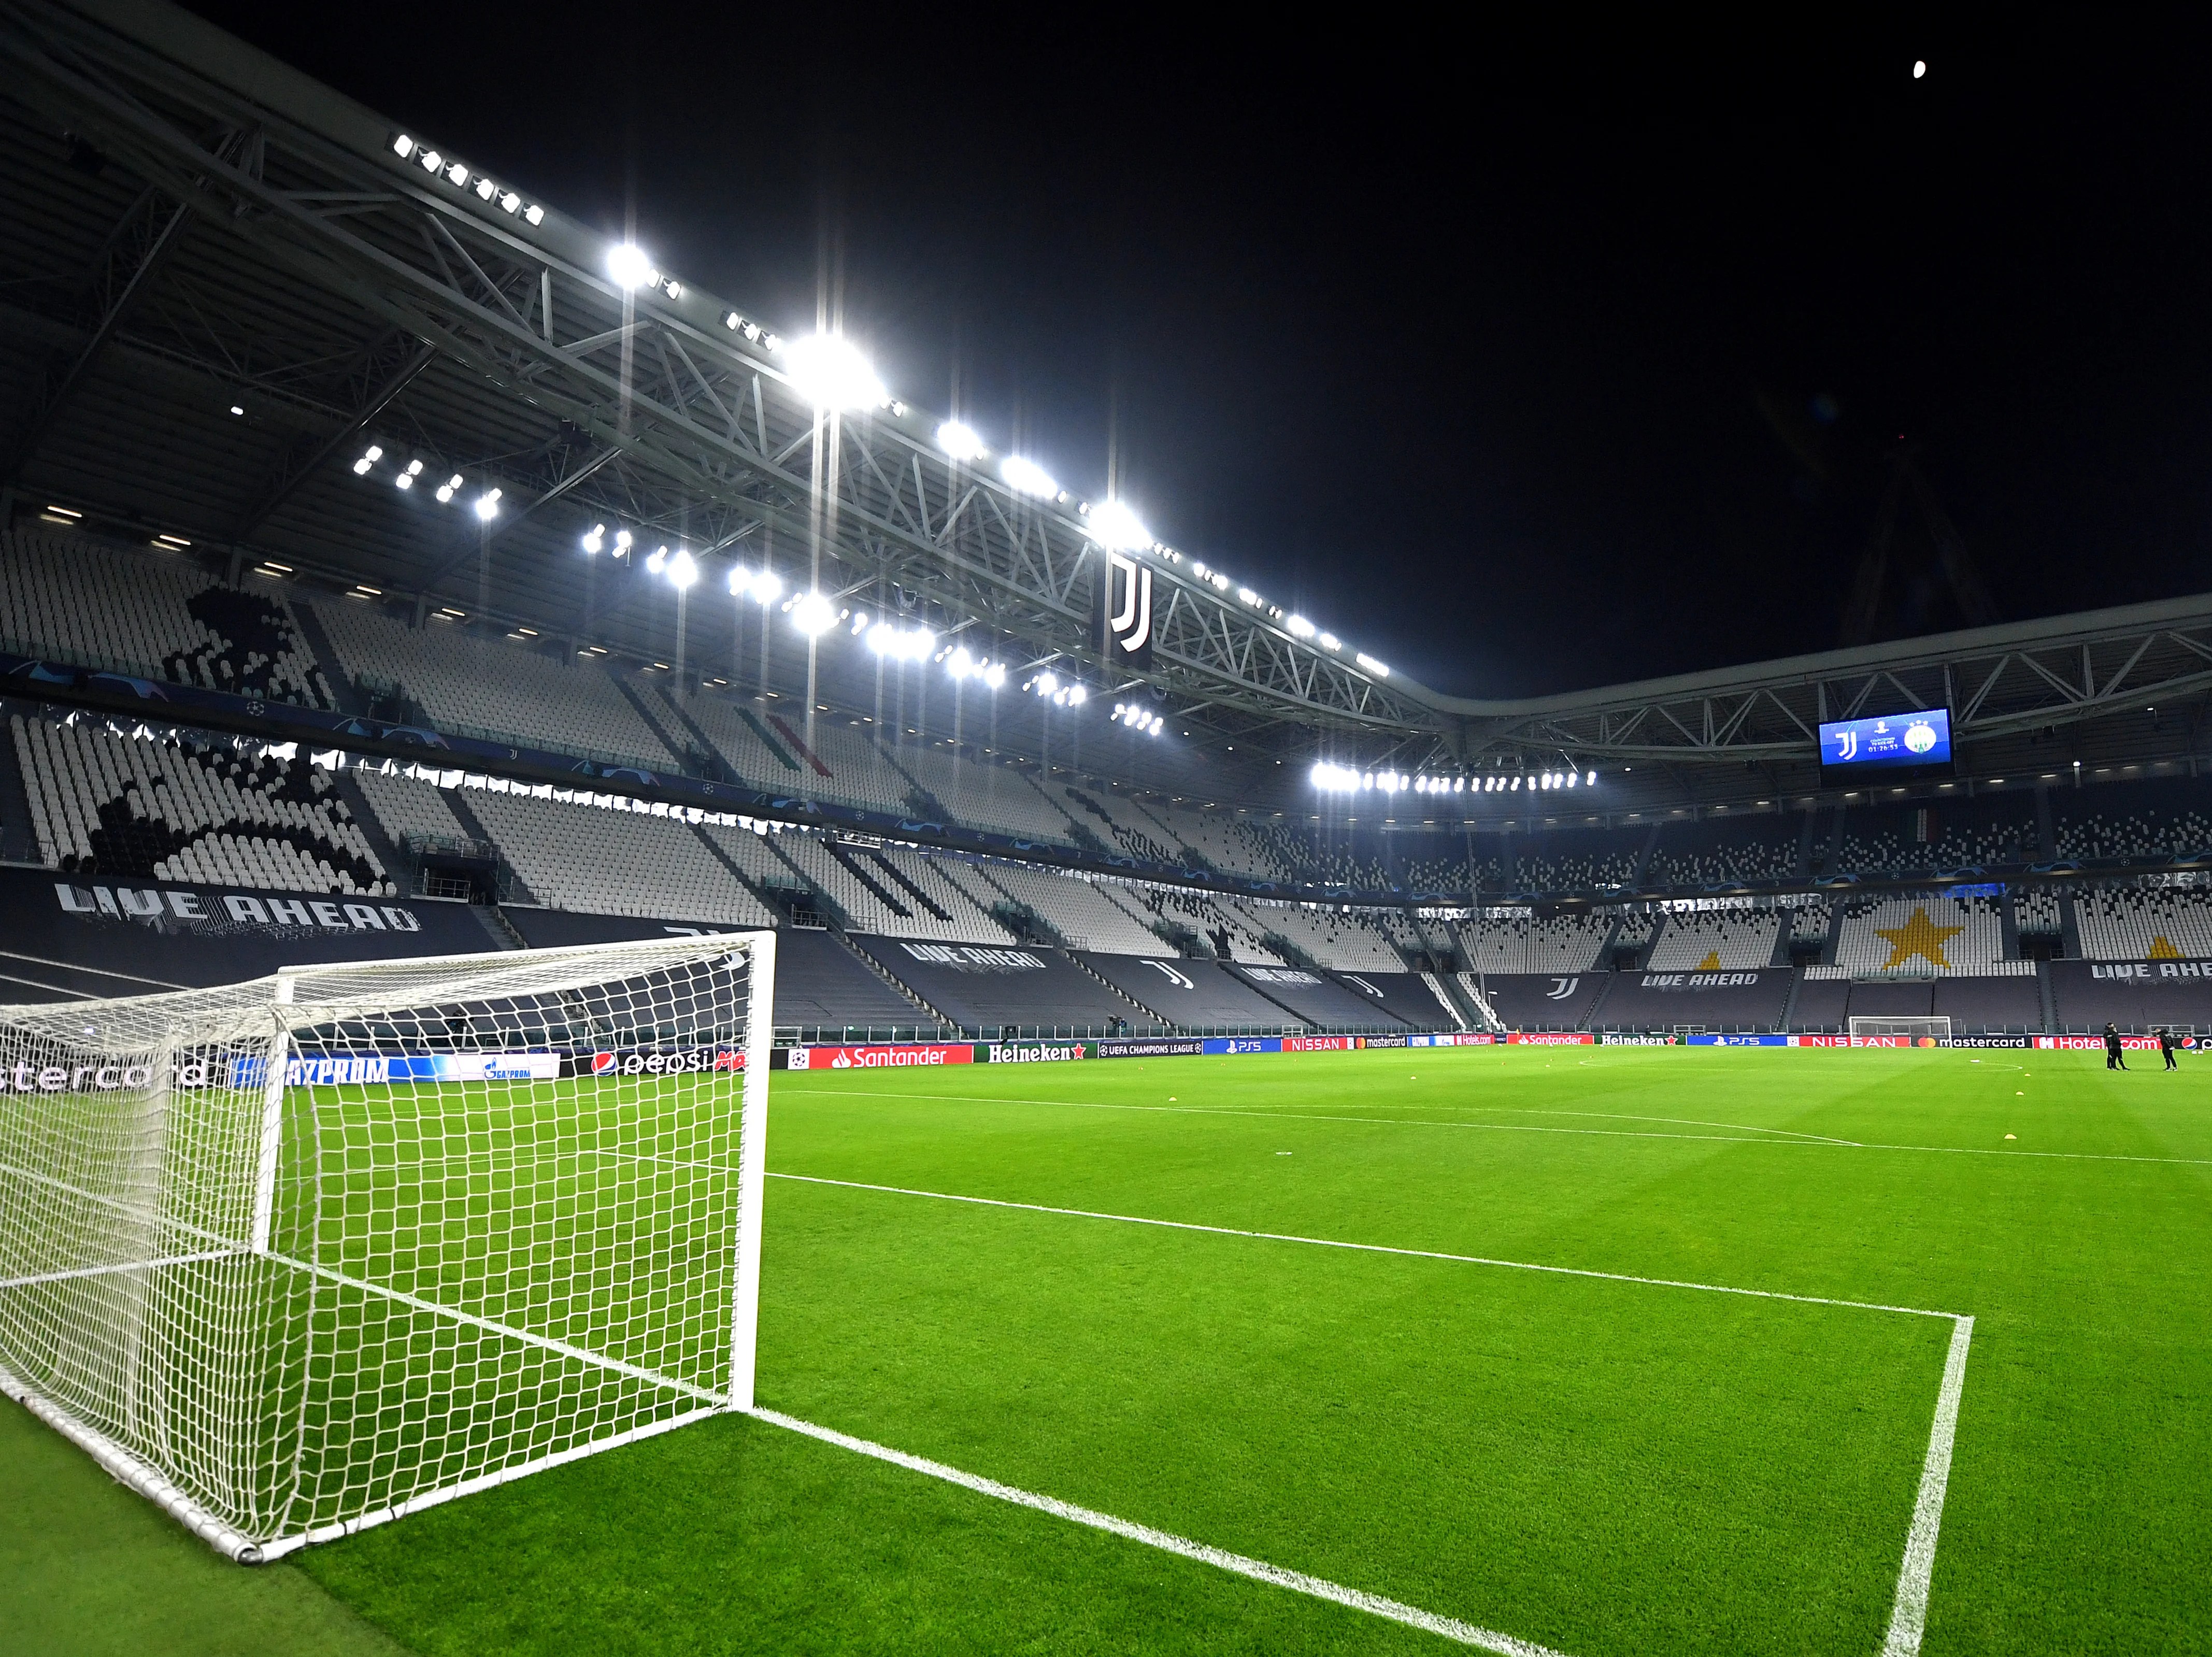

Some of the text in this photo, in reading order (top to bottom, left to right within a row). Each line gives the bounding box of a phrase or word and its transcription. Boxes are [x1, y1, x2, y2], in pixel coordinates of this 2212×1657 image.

[54, 883, 422, 932] LIVE AHEAD
[900, 943, 1046, 968] LIVE AHEAD
[2091, 964, 2151, 979] LIVE
[1641, 974, 1759, 987] LIVE AHEAD
[1292, 1038, 1339, 1051] NISSAN
[1366, 1036, 1405, 1048] mastercard
[1463, 1034, 1491, 1045] Hotels.com
[1529, 1035, 1582, 1045] Santander
[1602, 1035, 1665, 1046] Heineken
[1813, 1037, 1896, 1047] NISSAN
[1939, 1037, 2025, 1048] mastercard
[1109, 1044, 1194, 1055] UEFA CHAMPIONS LEAGUE
[1239, 1041, 1261, 1052] PS5
[853, 1047, 947, 1068] Santander
[989, 1044, 1071, 1063] Heineken
[623, 1050, 708, 1076] pepsi
[286, 1059, 389, 1085] AZPROM
